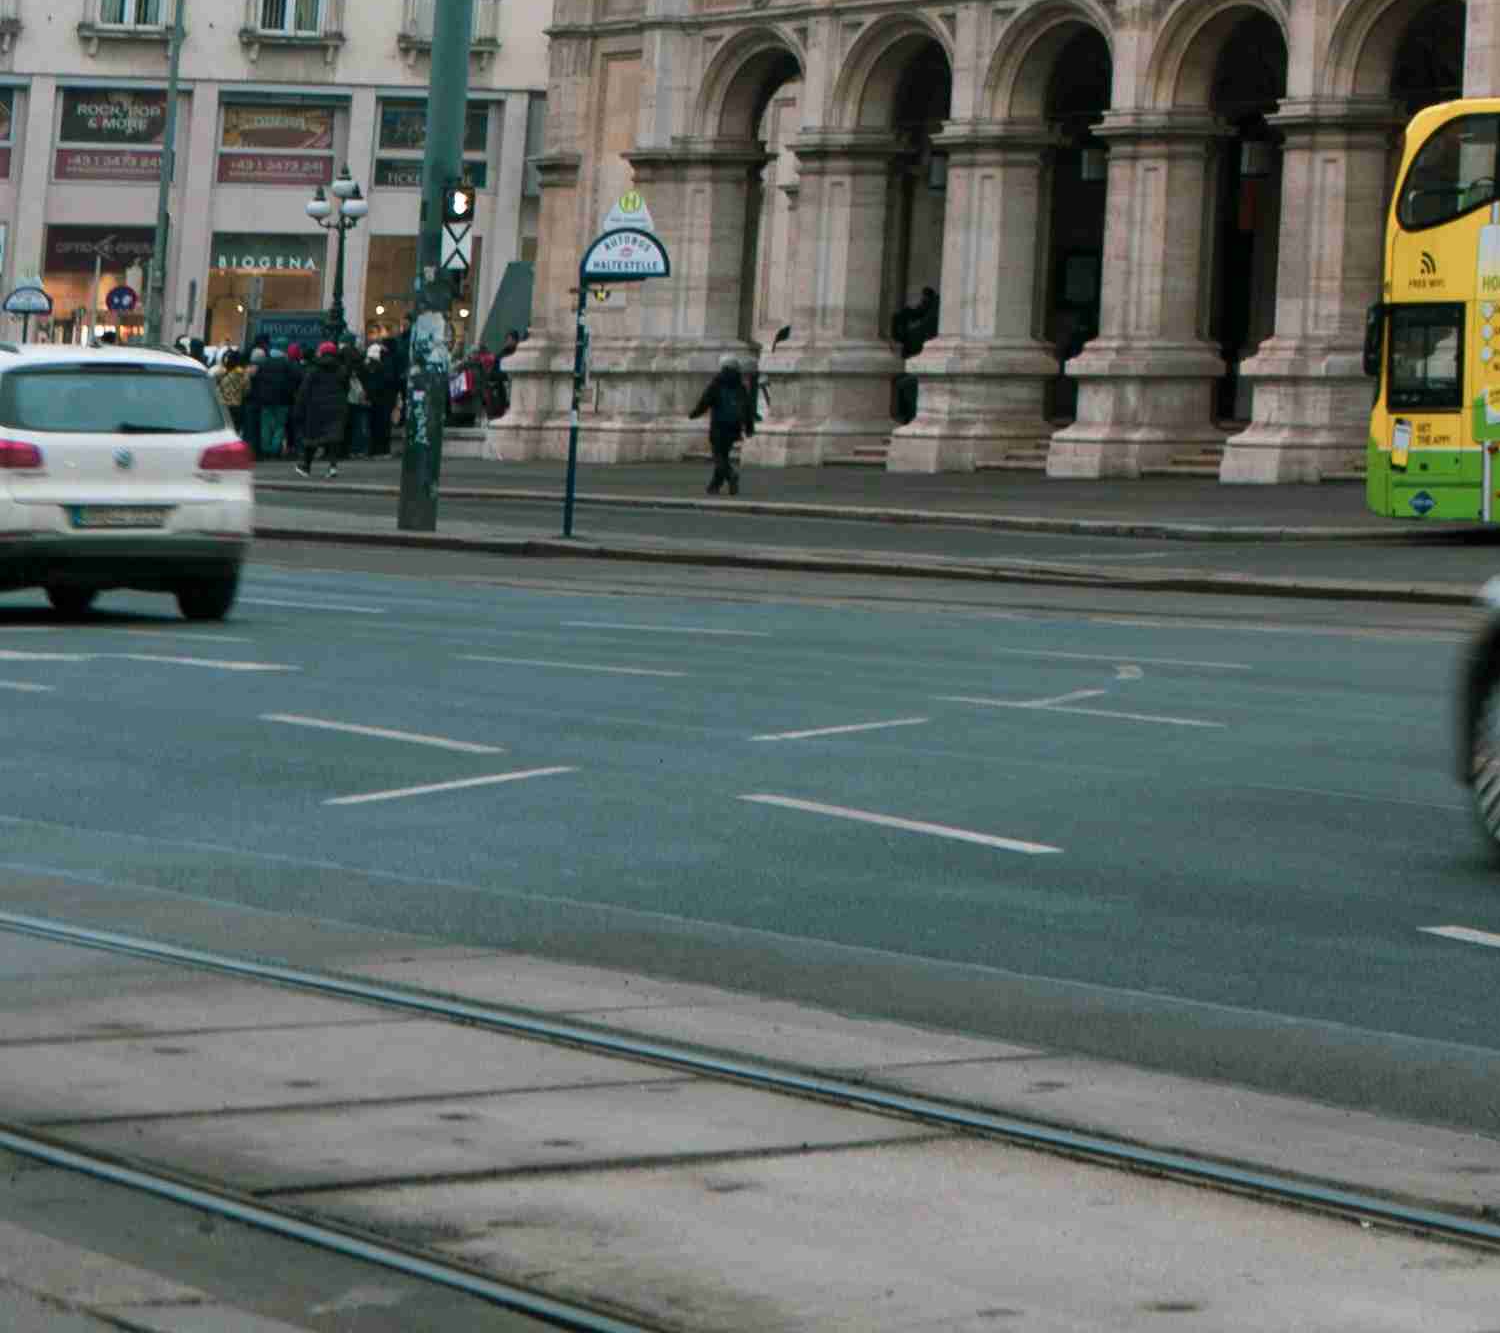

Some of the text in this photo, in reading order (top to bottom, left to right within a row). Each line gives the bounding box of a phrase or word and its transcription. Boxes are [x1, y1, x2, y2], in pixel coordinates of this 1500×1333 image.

[218, 254, 317, 270] BIOGENA
[593, 260, 657, 270] HALTESTELLE
[1416, 422, 1432, 432] GET
[1416, 435, 1431, 446] THE
